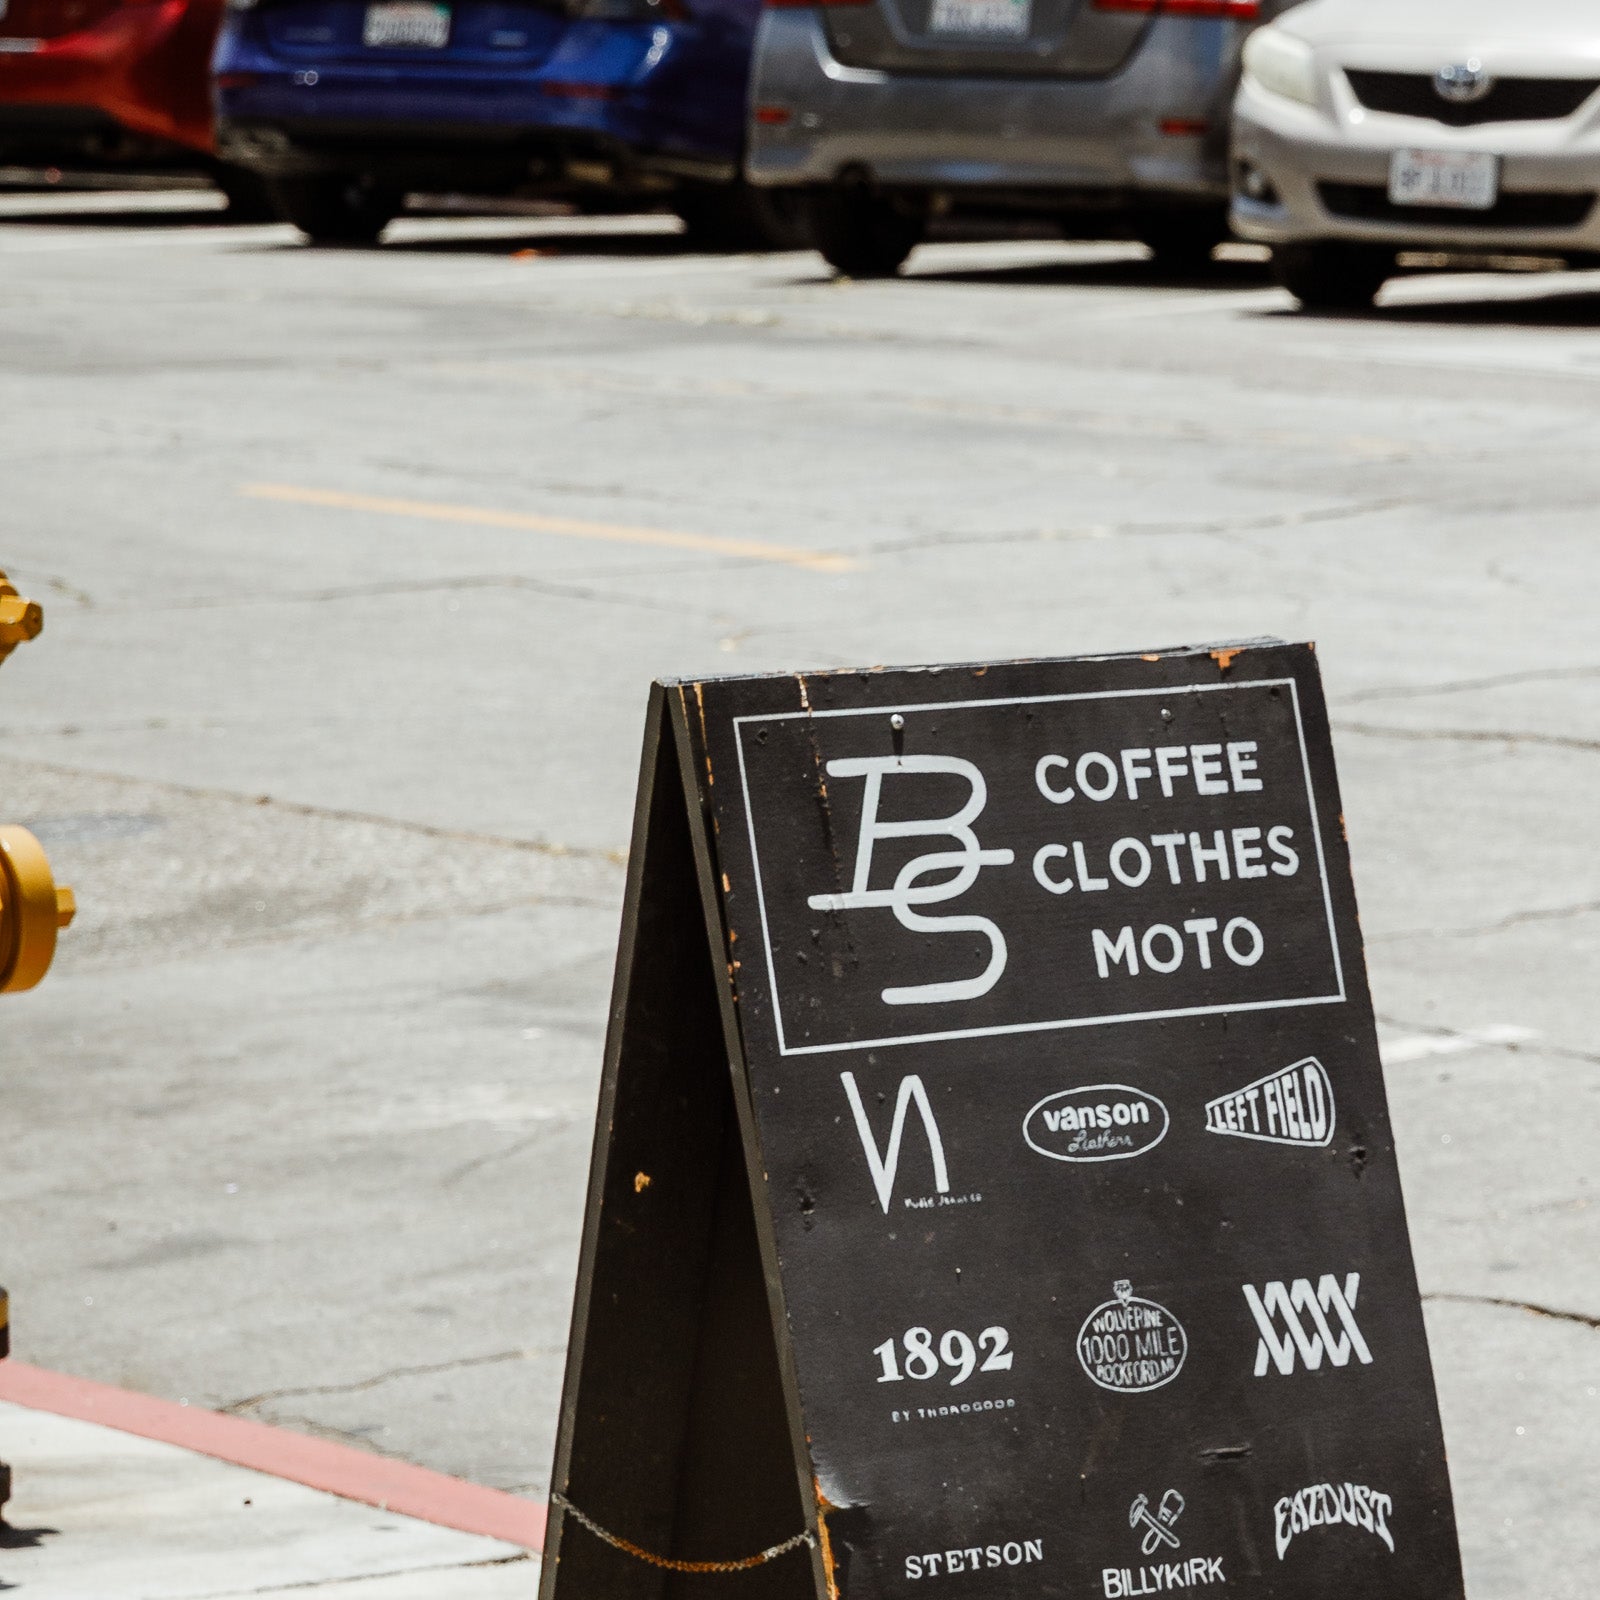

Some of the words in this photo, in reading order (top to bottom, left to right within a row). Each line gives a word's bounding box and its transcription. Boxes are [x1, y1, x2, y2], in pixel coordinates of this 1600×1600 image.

[1035, 741, 1263, 804] COFFEE
[1032, 826, 1300, 895] CLOTHES
[1092, 917, 1265, 979] MOTO
[1042, 1101, 1149, 1132] vanson
[1213, 1088, 1259, 1133] LEFT
[1263, 1064, 1326, 1140] FIELD
[1092, 1306, 1163, 1333] WOLVERINE
[873, 1326, 1014, 1387] 1892
[1082, 1333, 1130, 1365] 1000
[1135, 1326, 1180, 1358] MILE
[891, 1411, 910, 1423] BY
[905, 1539, 1043, 1579] STETSON
[1102, 1556, 1226, 1598] BILLYKIRK
